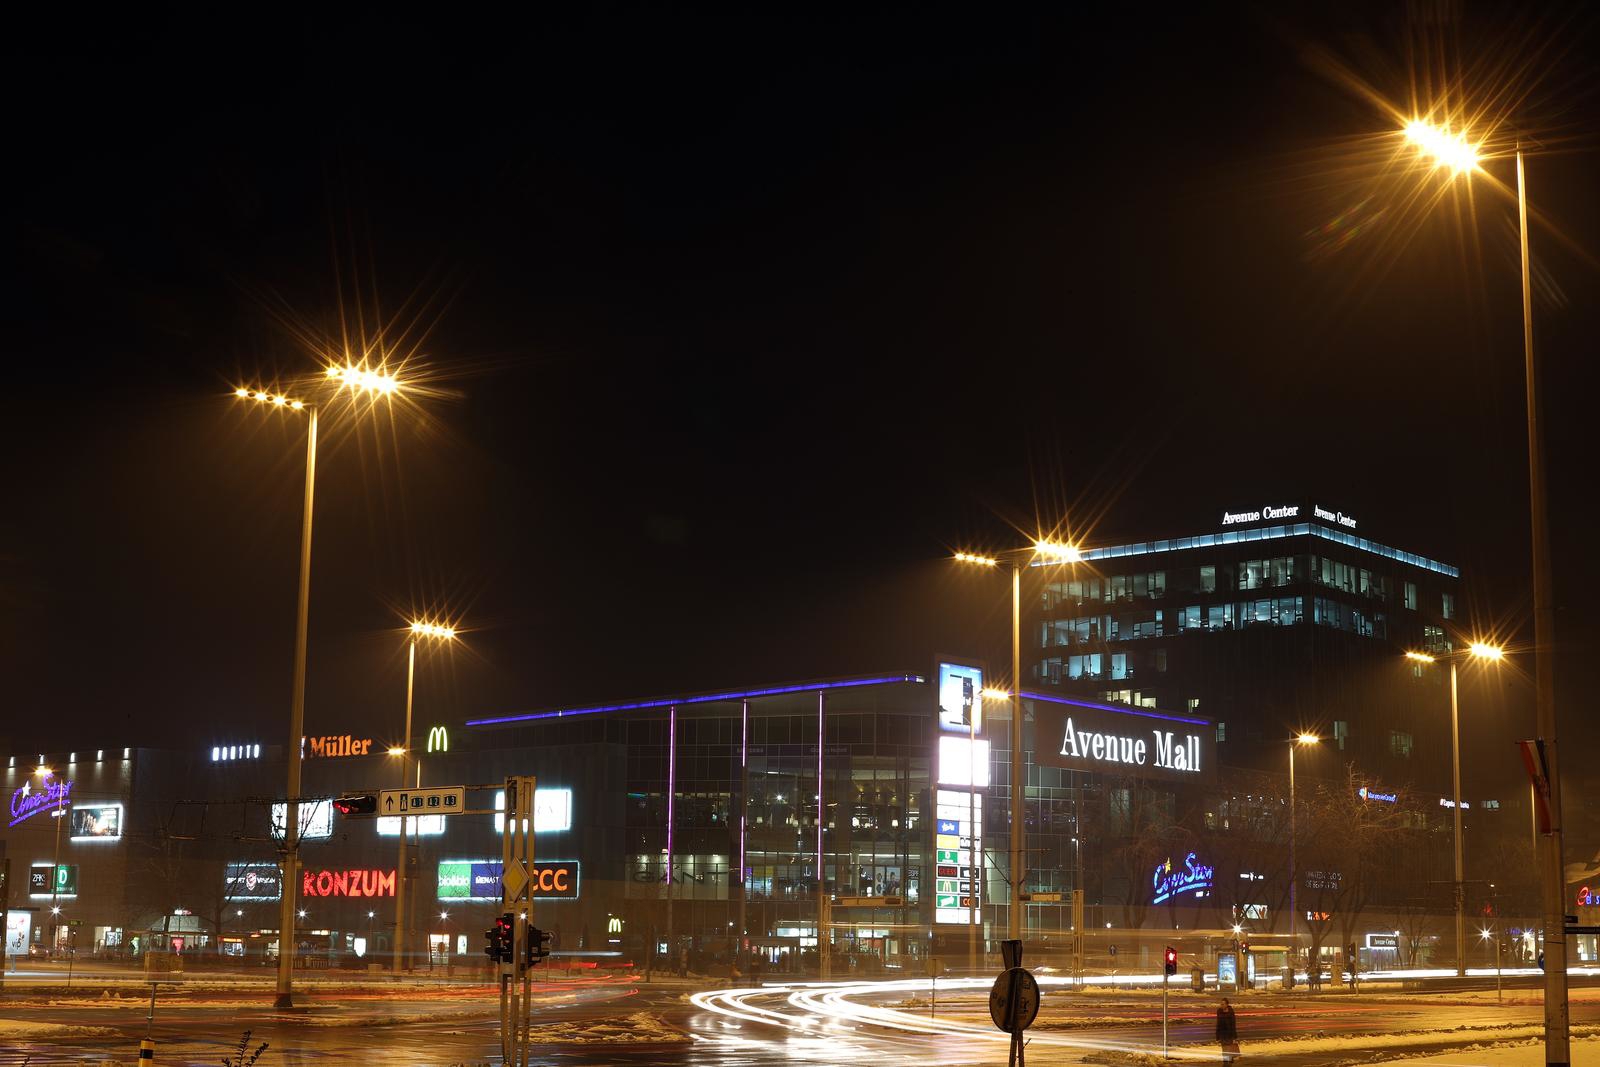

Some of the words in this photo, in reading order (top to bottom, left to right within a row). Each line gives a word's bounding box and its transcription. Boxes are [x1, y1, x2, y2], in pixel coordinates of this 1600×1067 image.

[1222, 511, 1260, 525] Avenue
[1262, 505, 1299, 519] Center
[1314, 504, 1336, 522] Avenue
[1336, 512, 1357, 528] Center
[310, 735, 372, 758] Müller
[1060, 717, 1146, 765] Avenue
[1153, 730, 1200, 772] Mall
[303, 869, 396, 897] KONZUM
